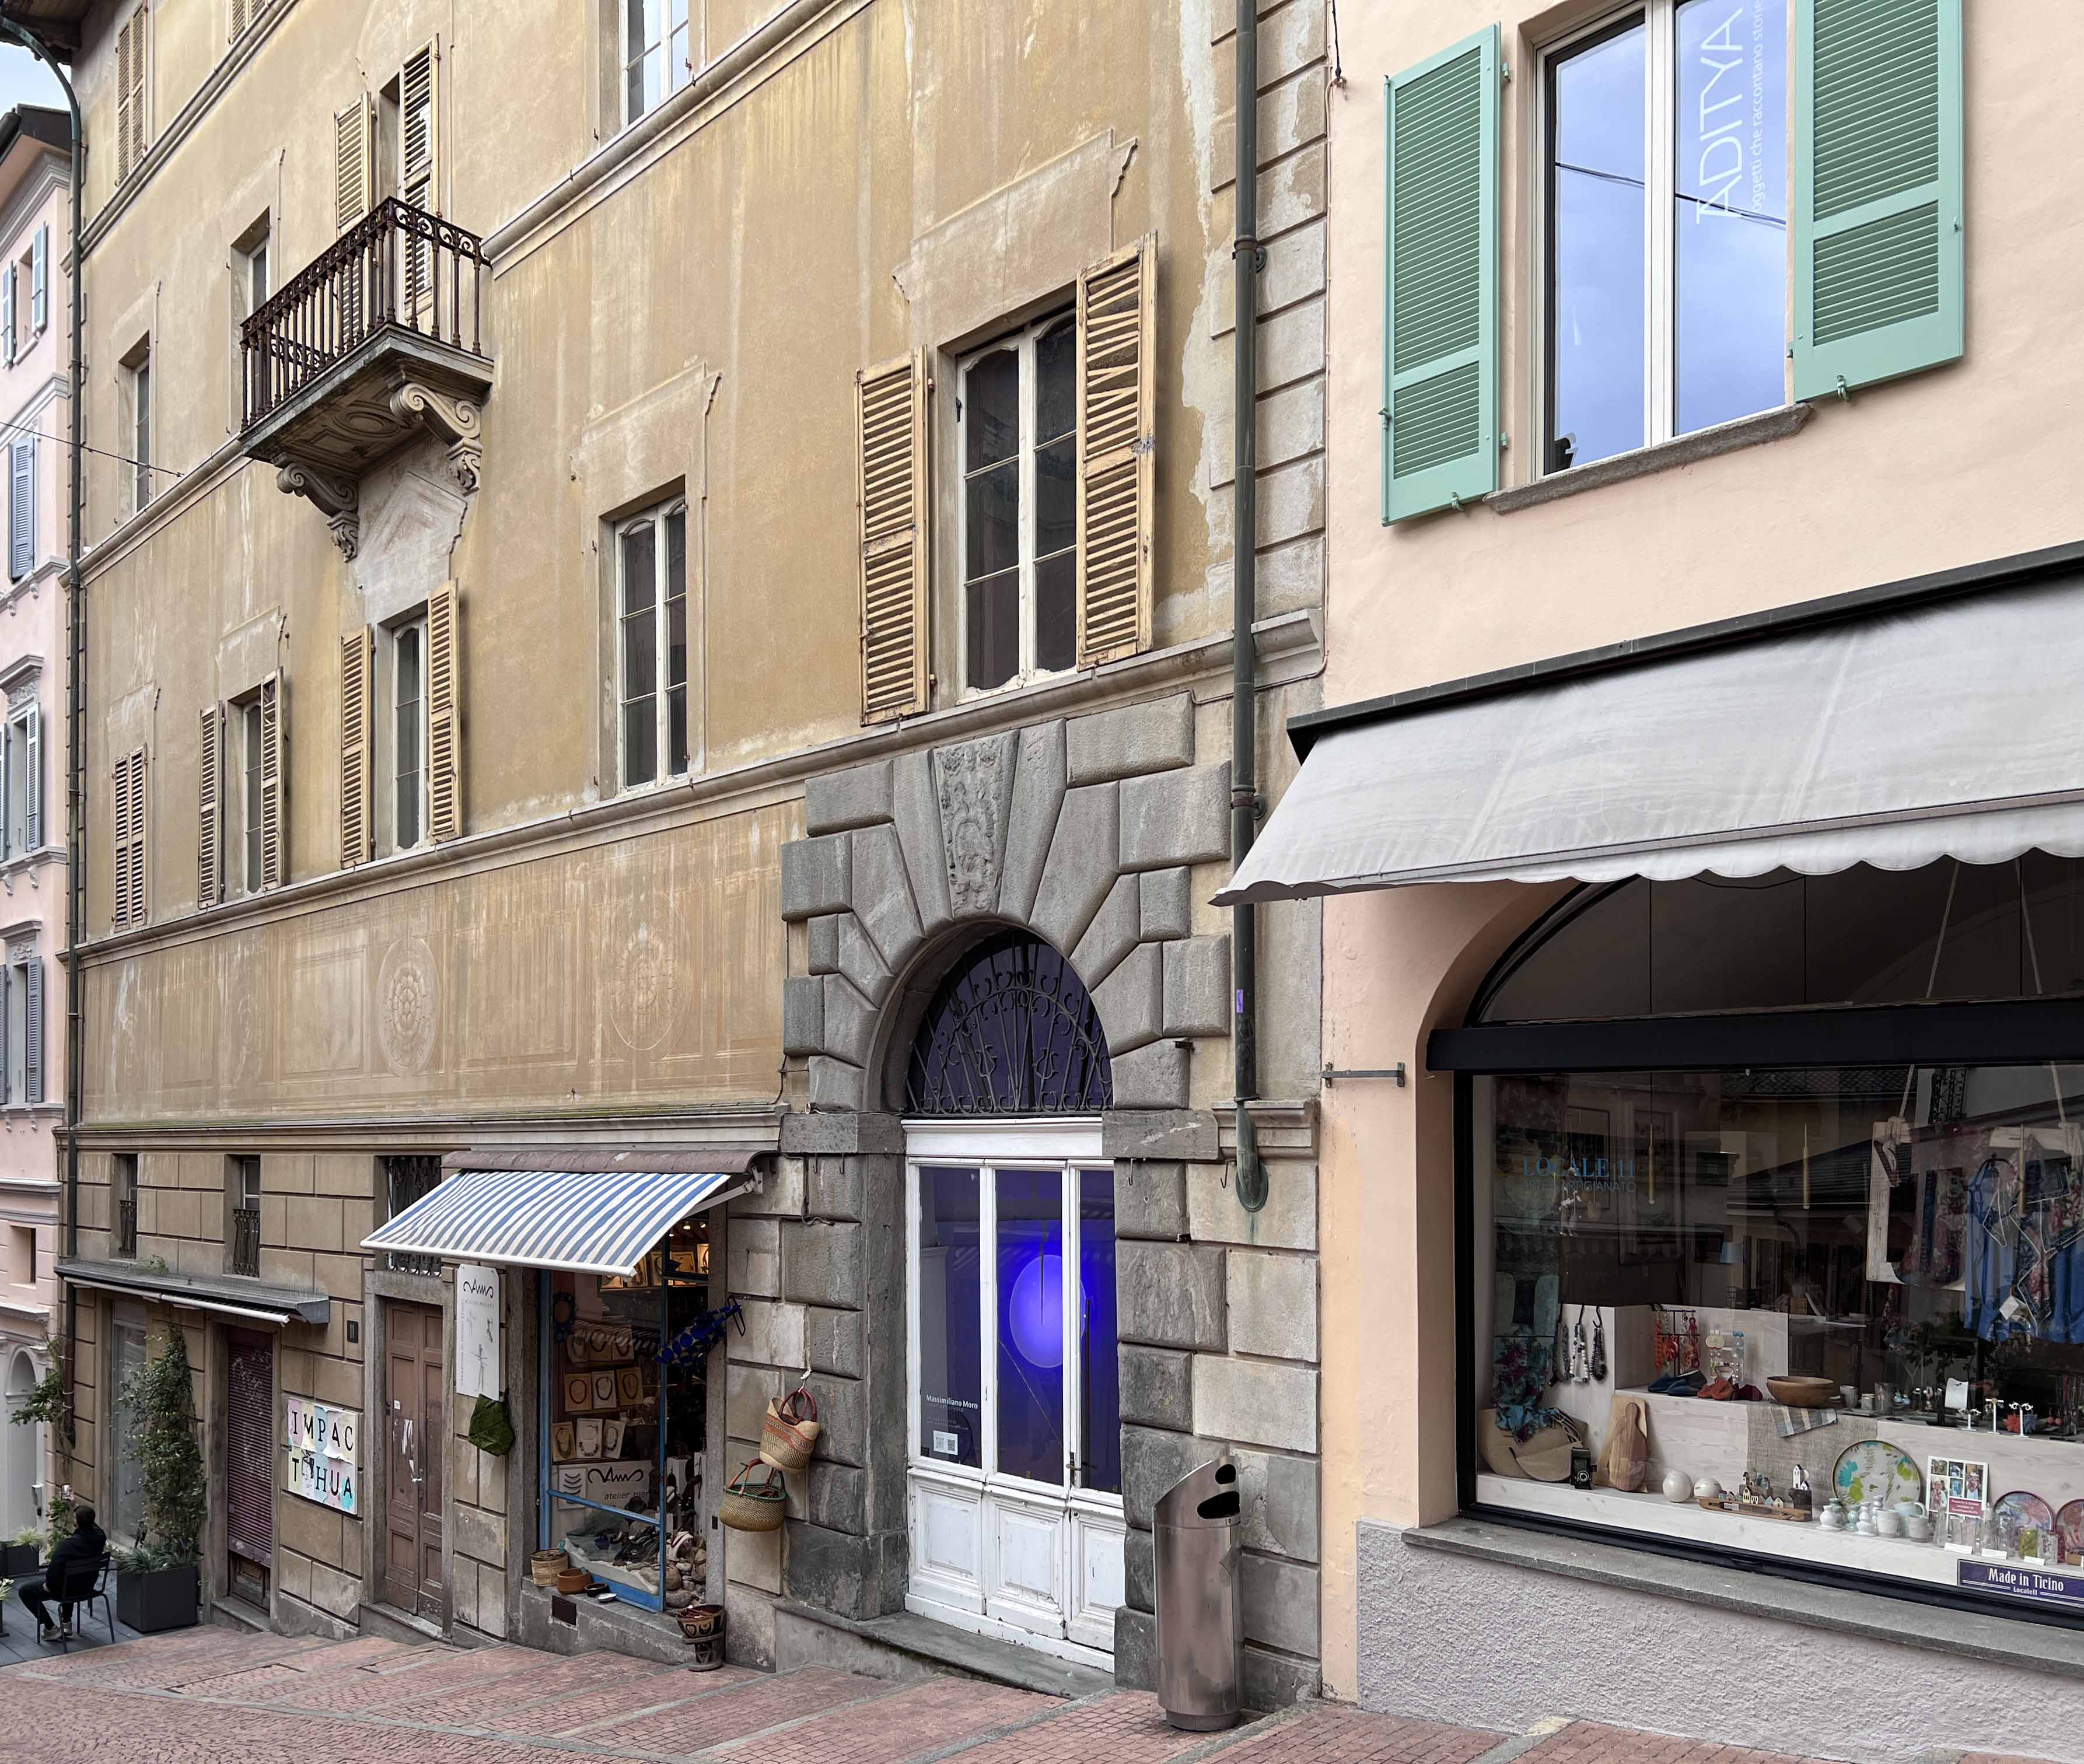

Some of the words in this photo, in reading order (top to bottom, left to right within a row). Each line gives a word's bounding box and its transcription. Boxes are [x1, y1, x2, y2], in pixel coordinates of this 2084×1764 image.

[1753, 43, 1764, 127] raccontano
[1697, 6, 1743, 224] ADITYA
[1750, 129, 1763, 156] che
[1751, 159, 1766, 211] oggetti
[1523, 1157, 1609, 1177] LOCALE
[1561, 1180, 1637, 1193] ARTIGIANATO
[926, 1395, 962, 1407] Massimiliano
[963, 1400, 978, 1409] Moro
[603, 1491, 631, 1500] atelier
[1988, 1567, 2016, 1584] Made
[2019, 1573, 2029, 1587] in
[2033, 1574, 2064, 1592] Ticino
